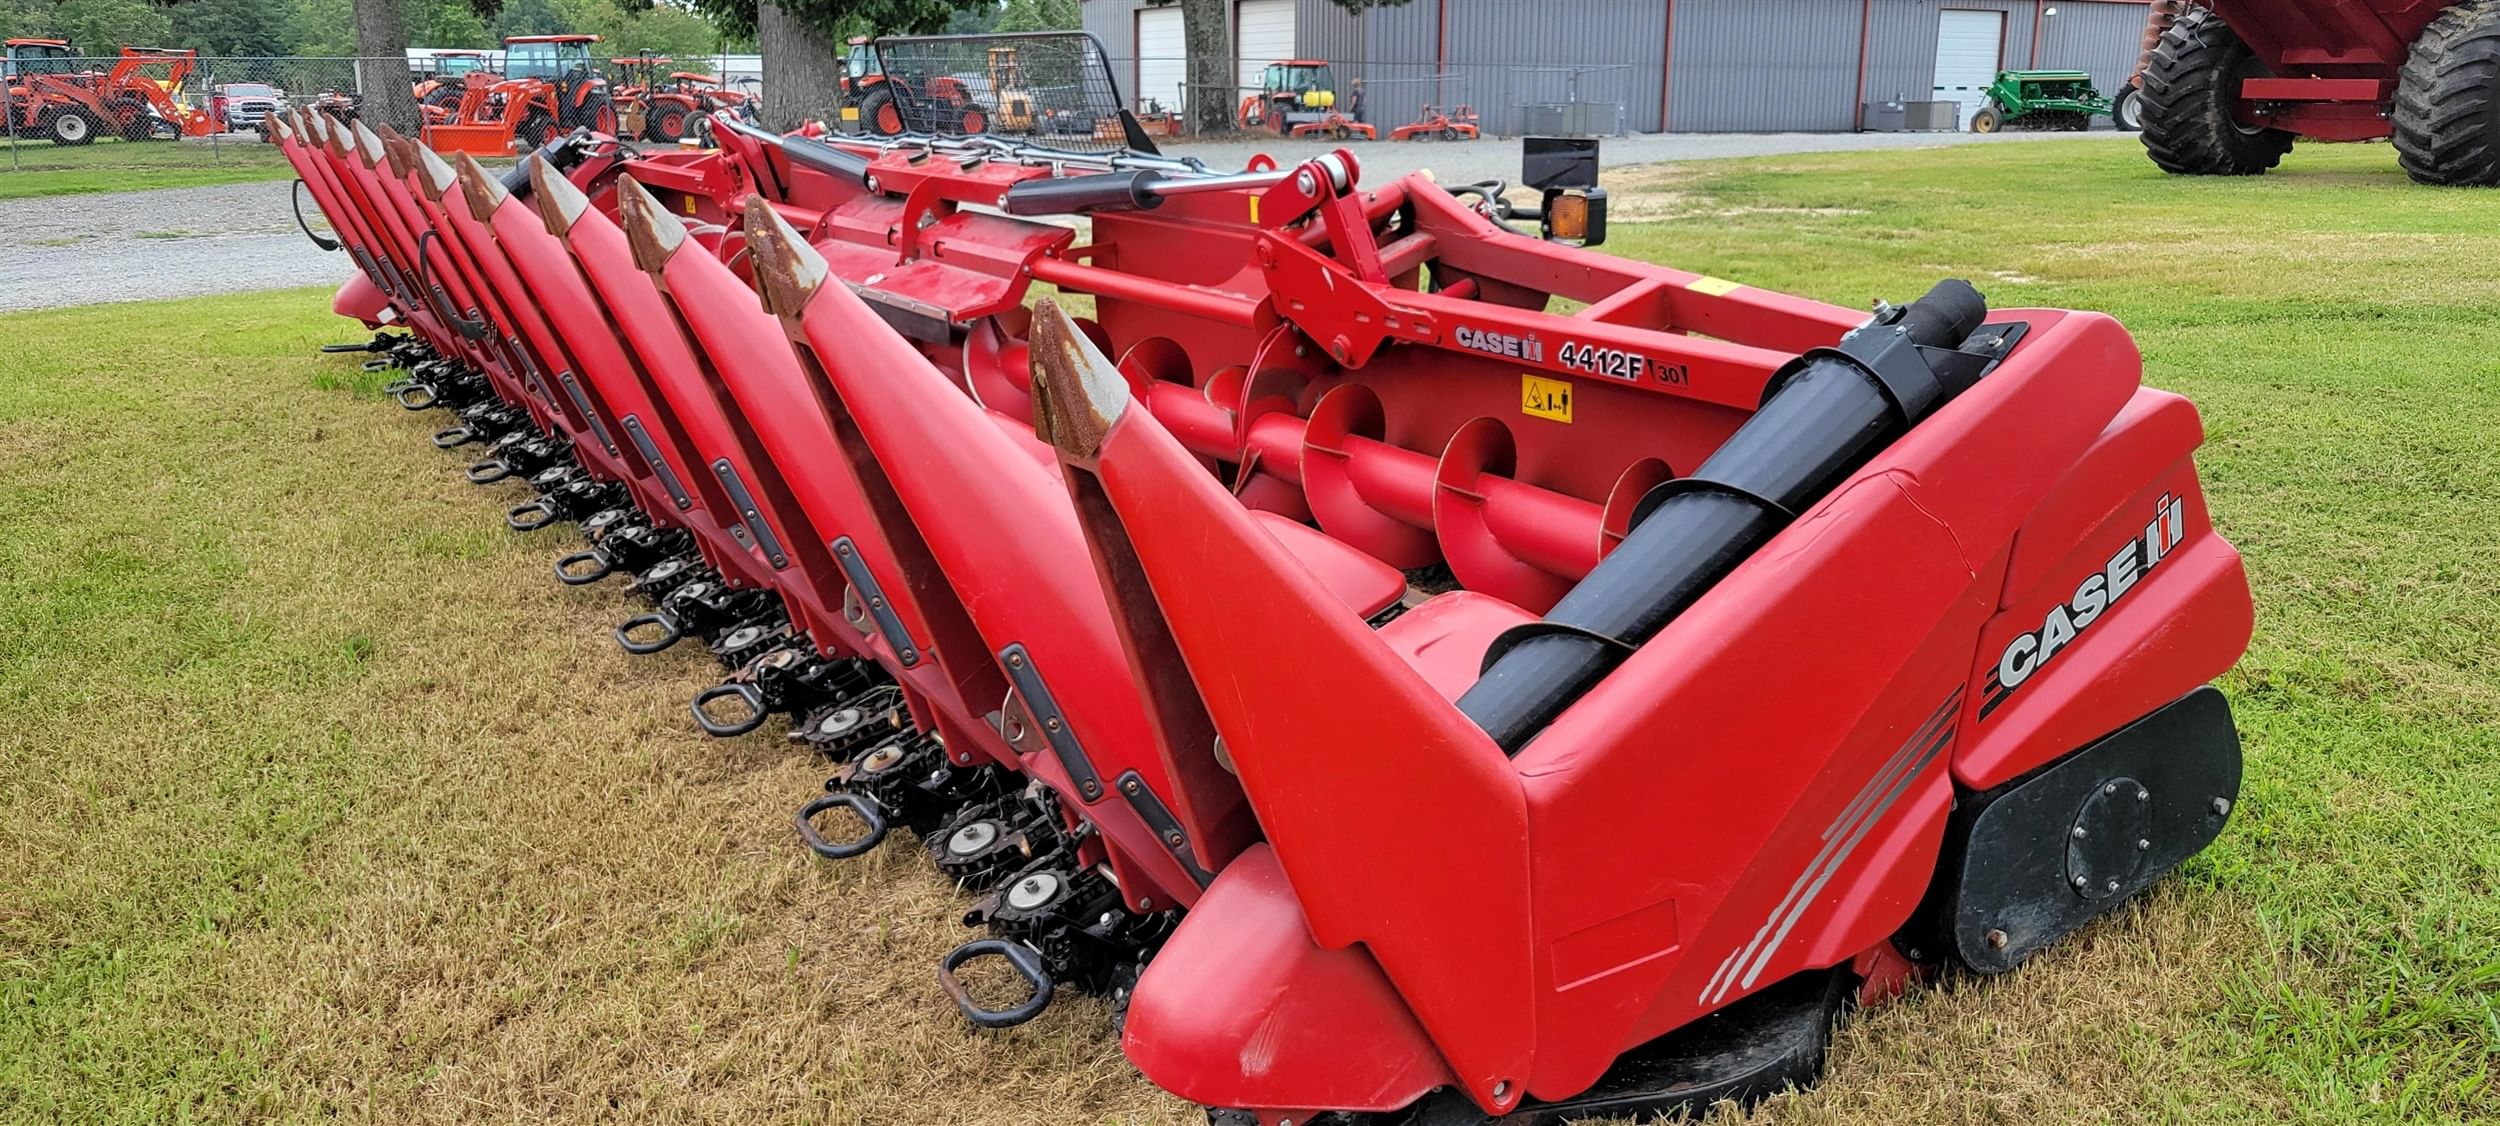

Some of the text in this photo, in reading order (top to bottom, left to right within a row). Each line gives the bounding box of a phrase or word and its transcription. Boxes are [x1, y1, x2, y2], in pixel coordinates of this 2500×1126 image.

[1455, 326, 1519, 357] CASE
[1559, 341, 1680, 384] 4412F 30
[1999, 539, 2138, 688] CASE
